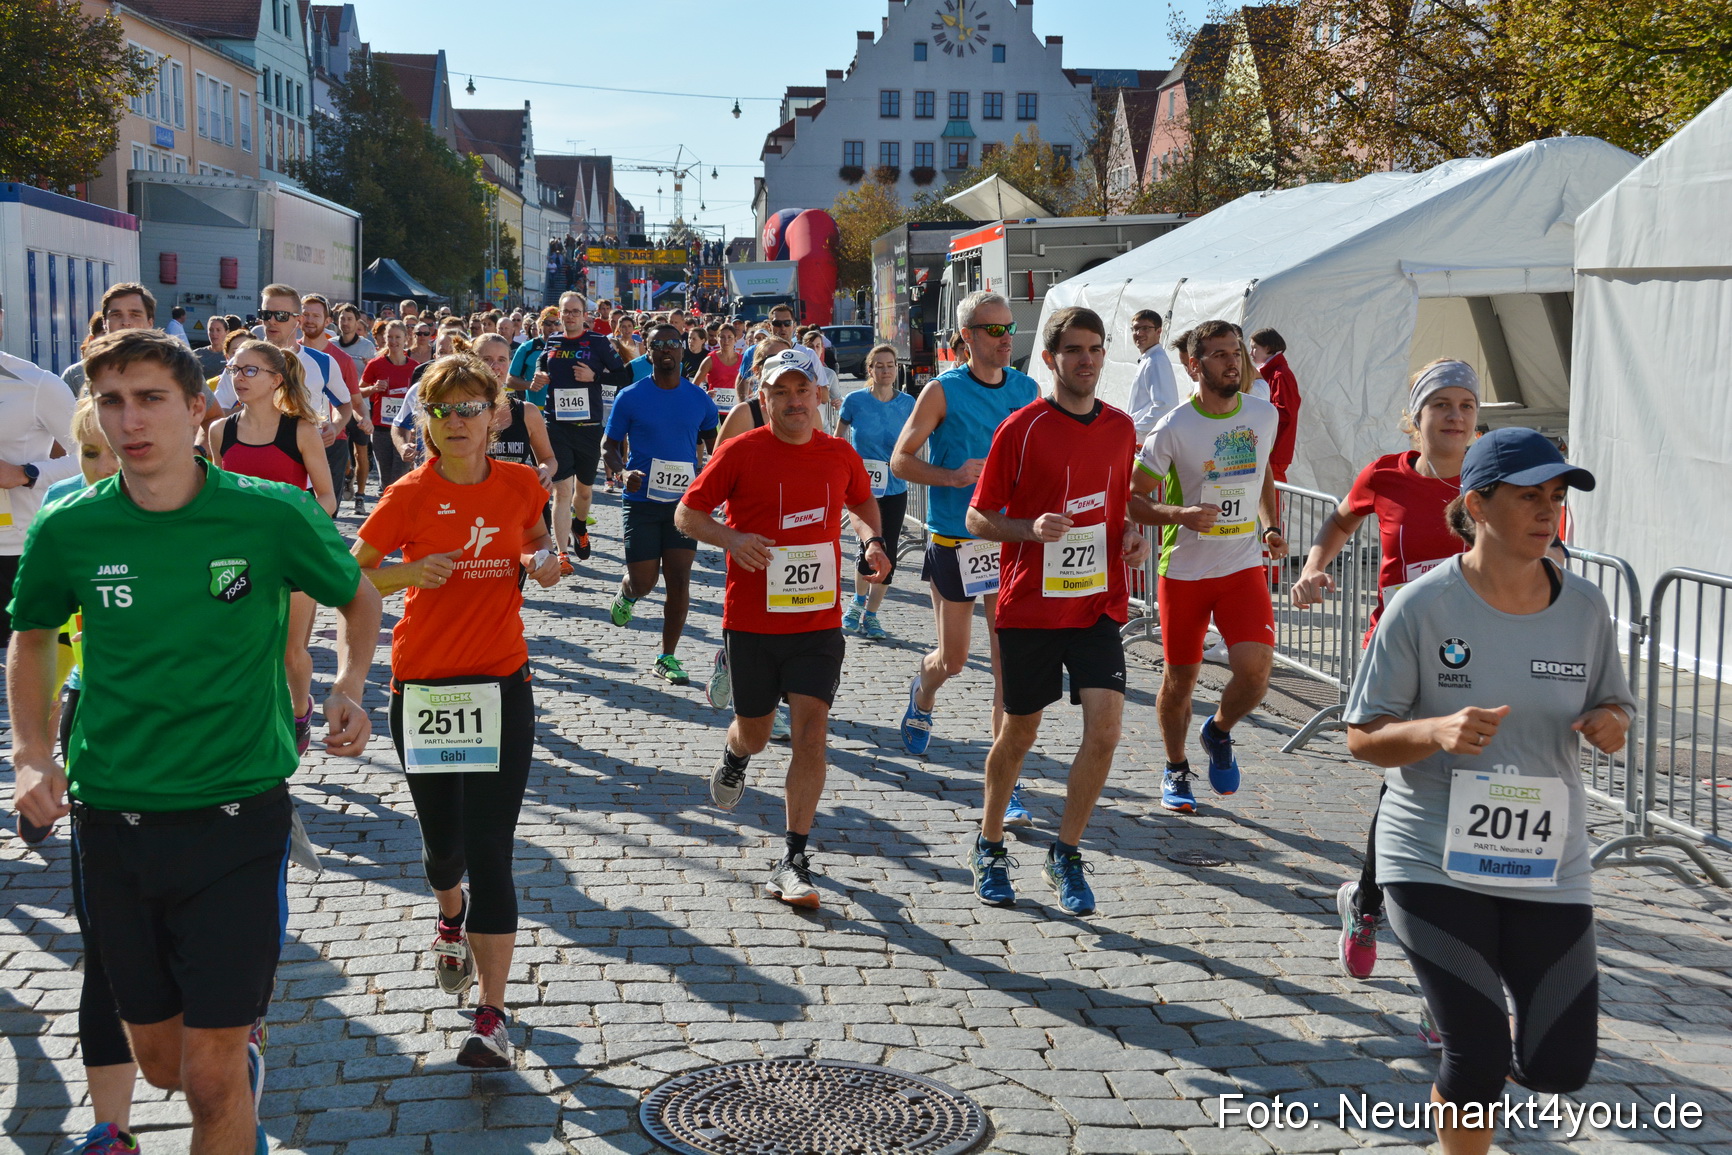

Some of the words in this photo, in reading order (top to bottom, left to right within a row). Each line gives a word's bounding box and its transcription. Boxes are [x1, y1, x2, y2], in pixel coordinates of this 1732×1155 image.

[619, 251, 654, 261] START
[747, 278, 779, 286] BOCK
[559, 396, 584, 408] 3146
[716, 394, 735, 403] 2557
[507, 441, 525, 454] NICHT
[1223, 463, 1257, 472] MARATHON
[1227, 457, 1254, 466] SCHWEIZ
[656, 471, 689, 487] 3122
[1220, 488, 1246, 496] BOCK
[1077, 498, 1095, 509] DEHN
[1221, 499, 1240, 517] 91
[794, 513, 814, 523] DEHN
[1067, 531, 1094, 542] BOCK
[1219, 526, 1240, 535] Sarah
[787, 550, 818, 560] BOCK
[1062, 544, 1095, 568] 272
[968, 551, 1000, 575] 235
[97, 564, 129, 576] JAKO
[463, 566, 515, 580] neumarkt
[784, 562, 821, 585] 267
[217, 566, 236, 591] TSV
[1063, 578, 1094, 589] Dominik
[225, 576, 247, 600] 1965
[96, 584, 133, 608] TS
[791, 595, 815, 605] Mario
[1531, 660, 1586, 677] BOCK
[1438, 672, 1472, 683] PARTL
[1438, 681, 1472, 689] Neumarkt
[430, 692, 473, 704] BOCK
[418, 707, 483, 735] 2511
[440, 750, 466, 762] Gabi
[1489, 784, 1541, 801] BOCK
[1467, 803, 1552, 842] 2014
[1473, 842, 1499, 852] PARTL
[1499, 845, 1533, 854] Neumarkt
[1478, 857, 1532, 876] Martina
